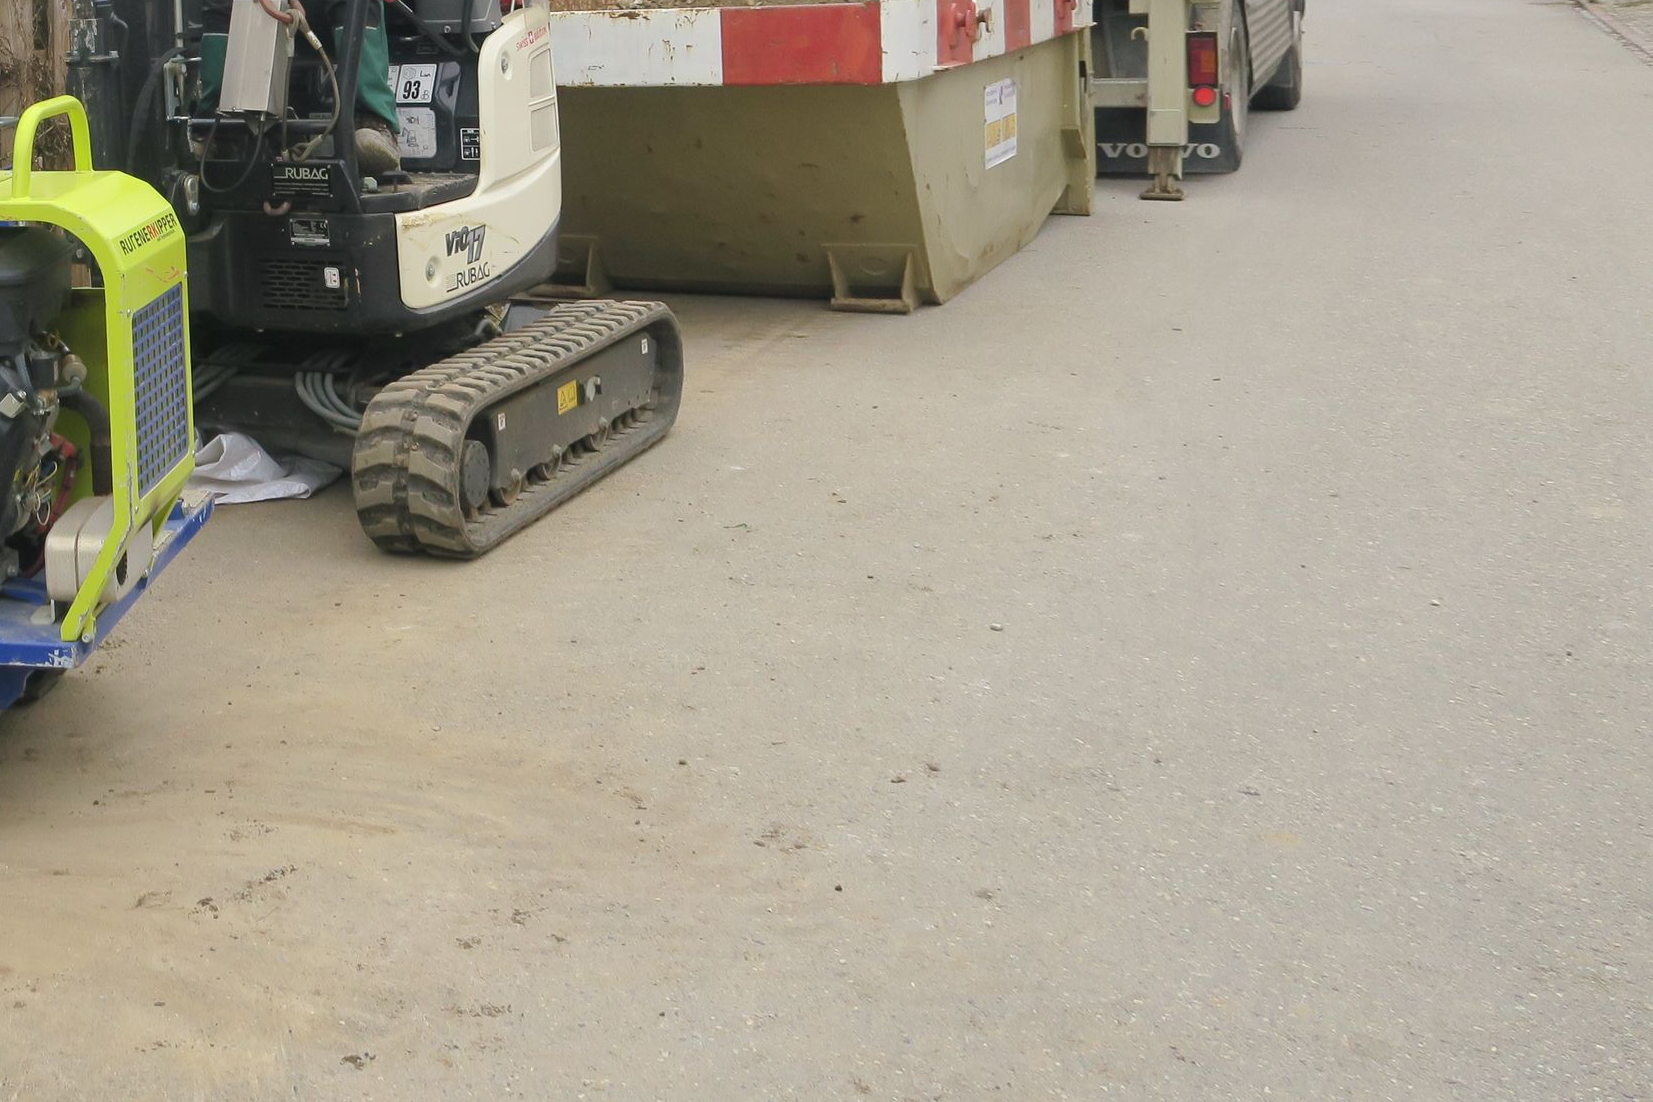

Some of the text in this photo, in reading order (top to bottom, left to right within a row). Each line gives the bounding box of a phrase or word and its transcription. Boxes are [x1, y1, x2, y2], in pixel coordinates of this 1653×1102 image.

[402, 80, 421, 100] 93
[1097, 143, 1221, 158] VOVO
[284, 167, 329, 179] RUBAG
[456, 262, 490, 289] RUBAG
